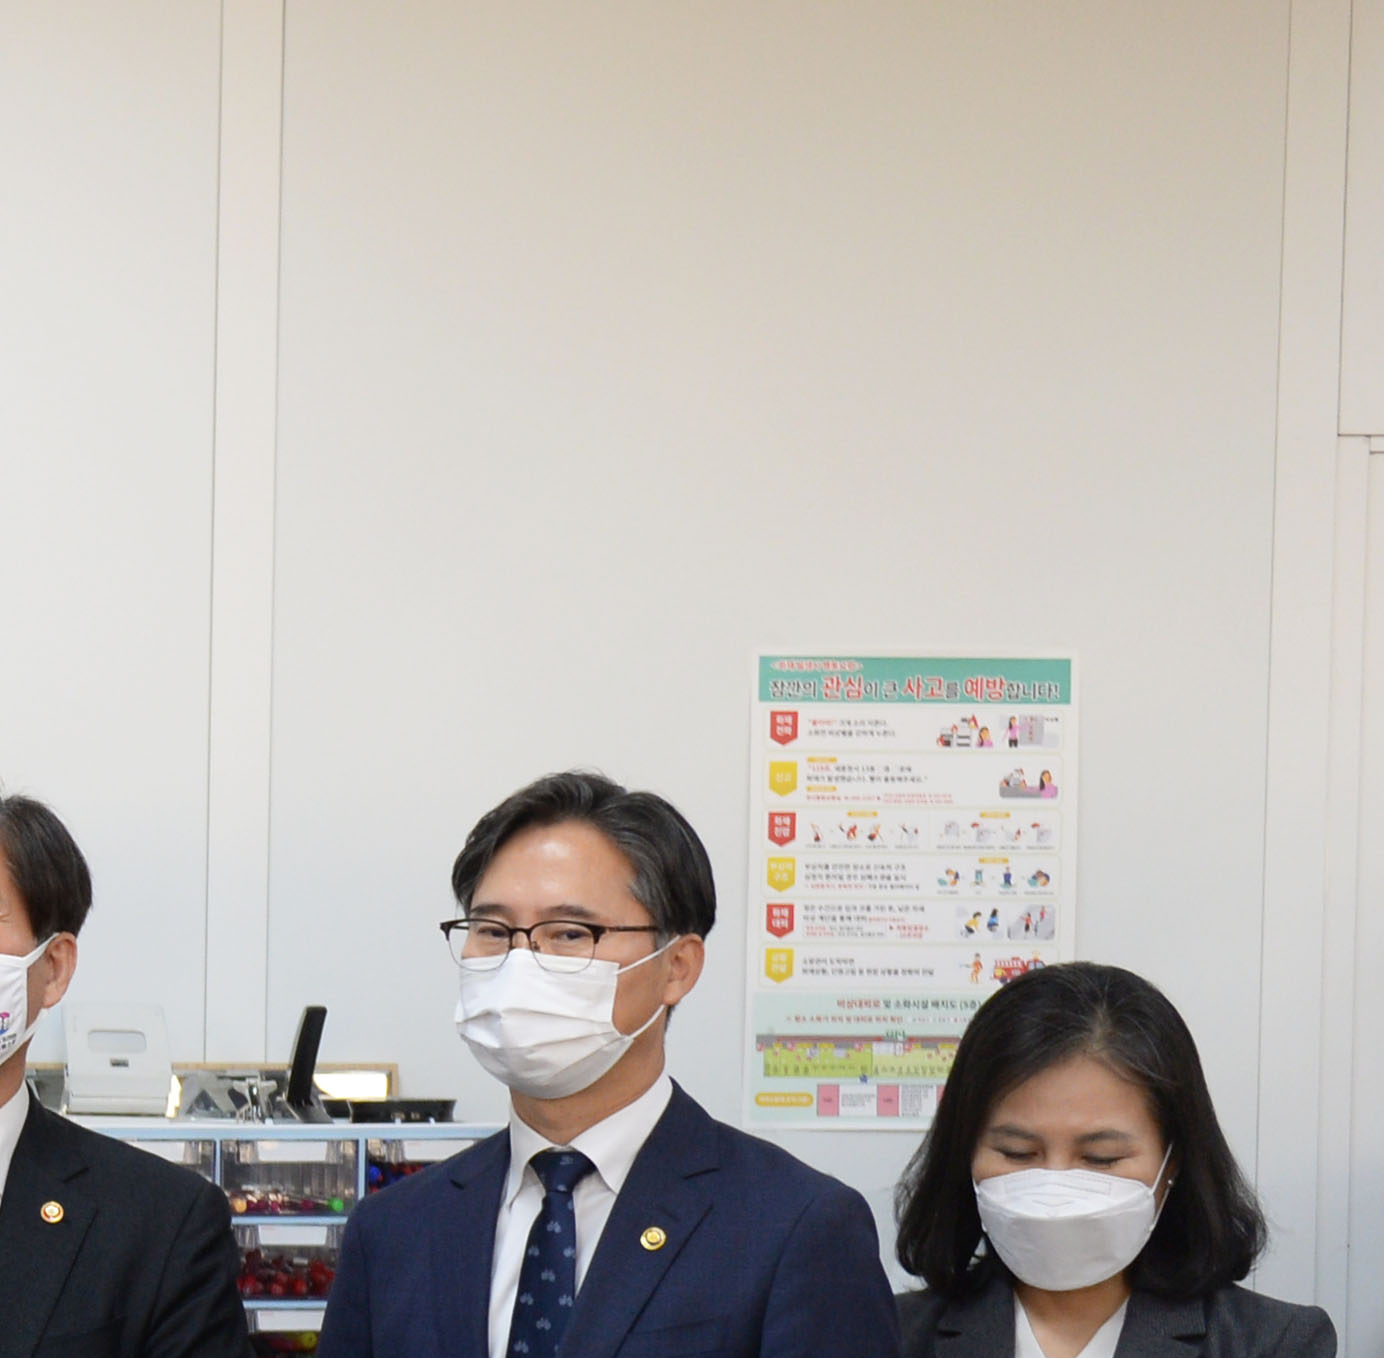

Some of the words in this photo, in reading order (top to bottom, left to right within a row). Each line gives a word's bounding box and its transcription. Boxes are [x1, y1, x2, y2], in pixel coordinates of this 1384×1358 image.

[769, 679, 817, 699] 잠깐의
[822, 674, 878, 700] 관심이
[883, 679, 898, 699] 큰
[901, 674, 959, 700] 사고를
[964, 675, 1060, 701] 예방합니다!
